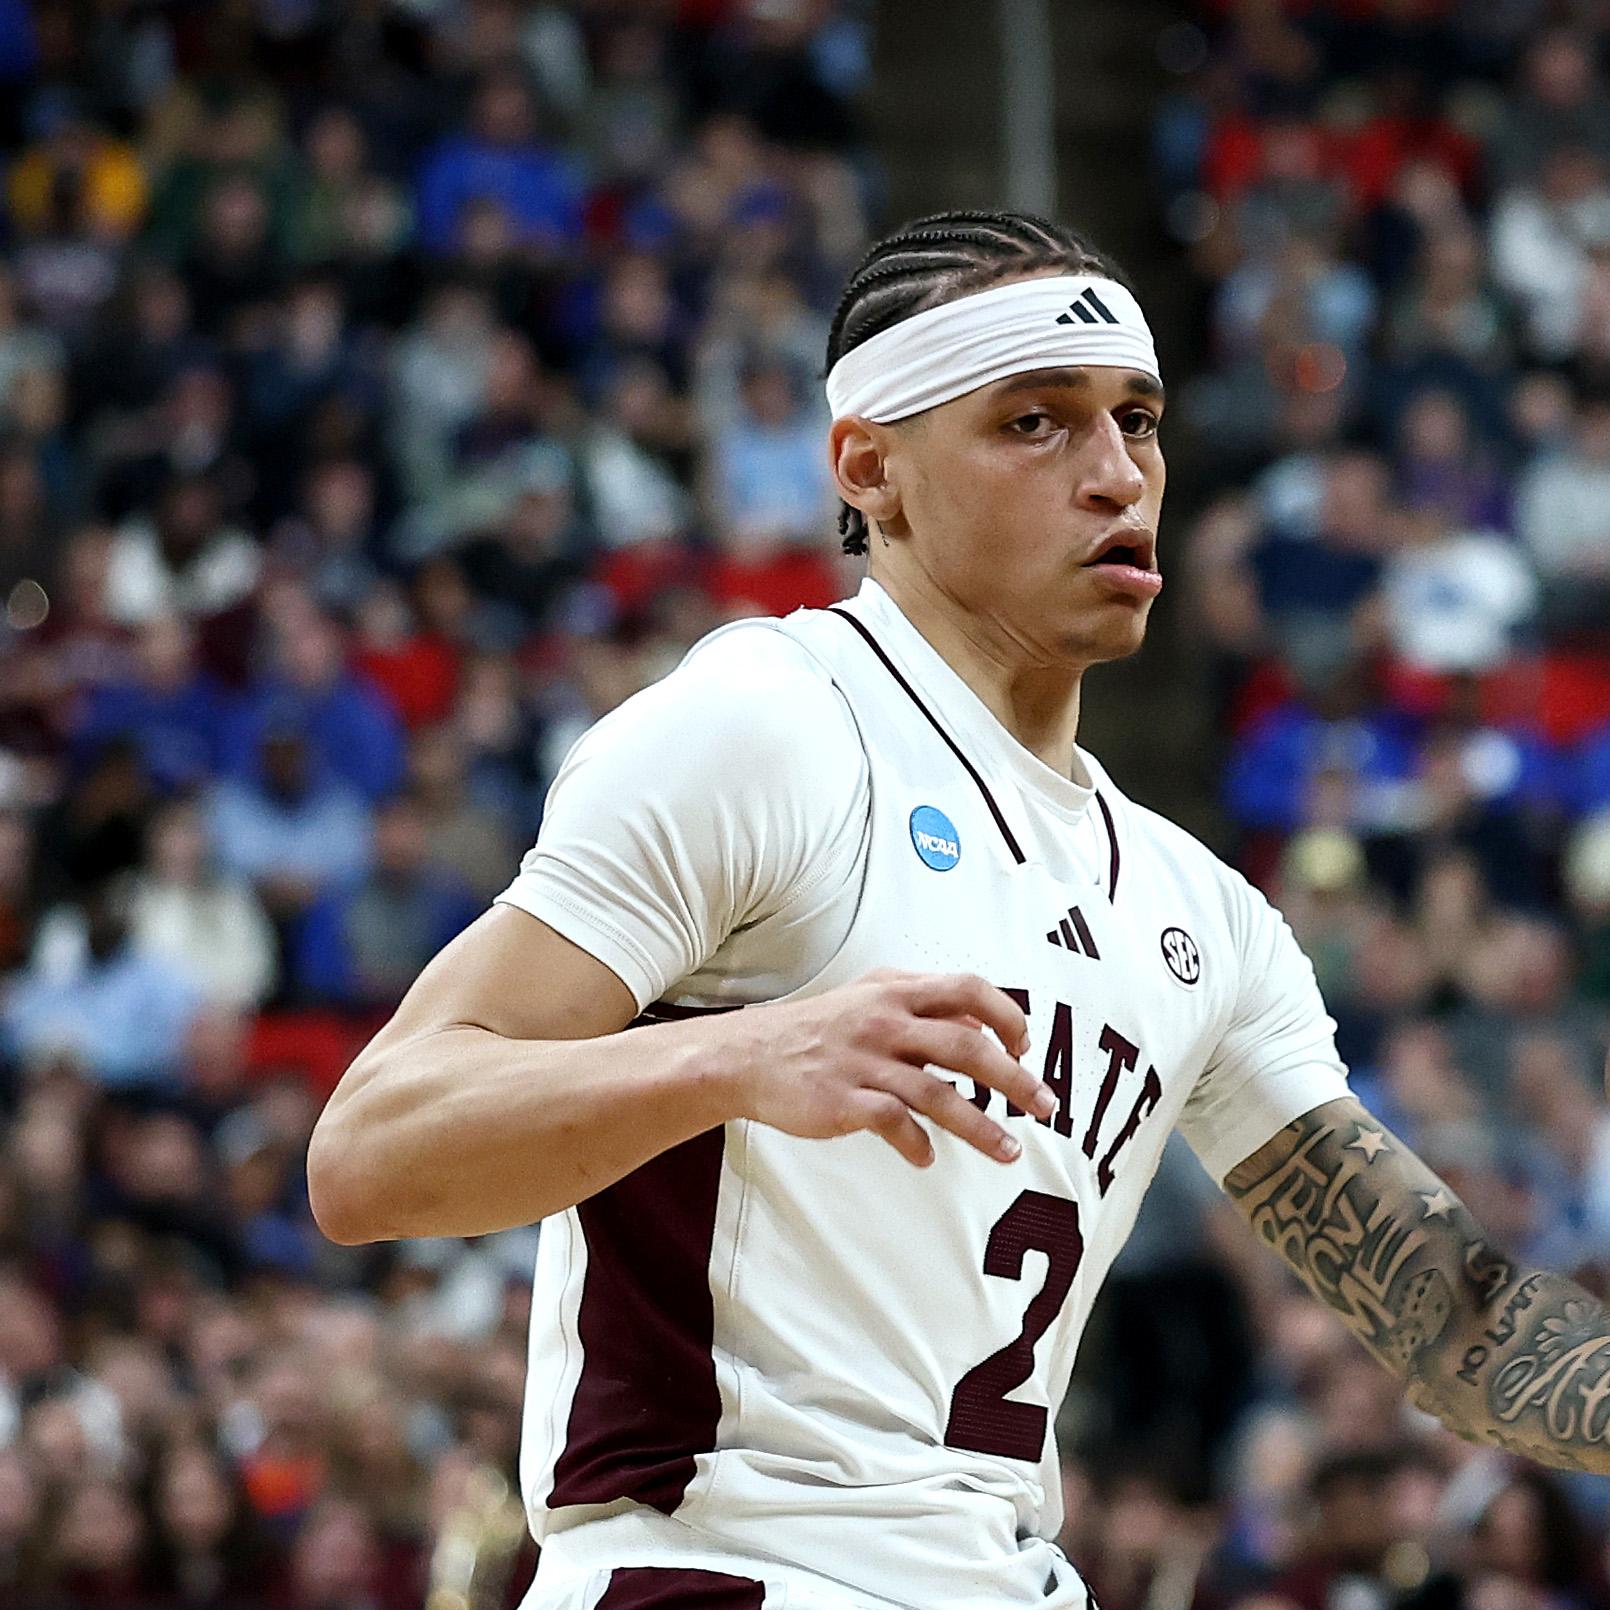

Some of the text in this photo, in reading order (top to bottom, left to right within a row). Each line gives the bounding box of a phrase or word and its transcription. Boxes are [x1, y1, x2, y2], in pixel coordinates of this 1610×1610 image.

[916, 831, 959, 859] NCAA
[1161, 929, 1200, 984] SEC
[940, 986, 1162, 1199] ATE
[945, 1189, 1084, 1463] 2
